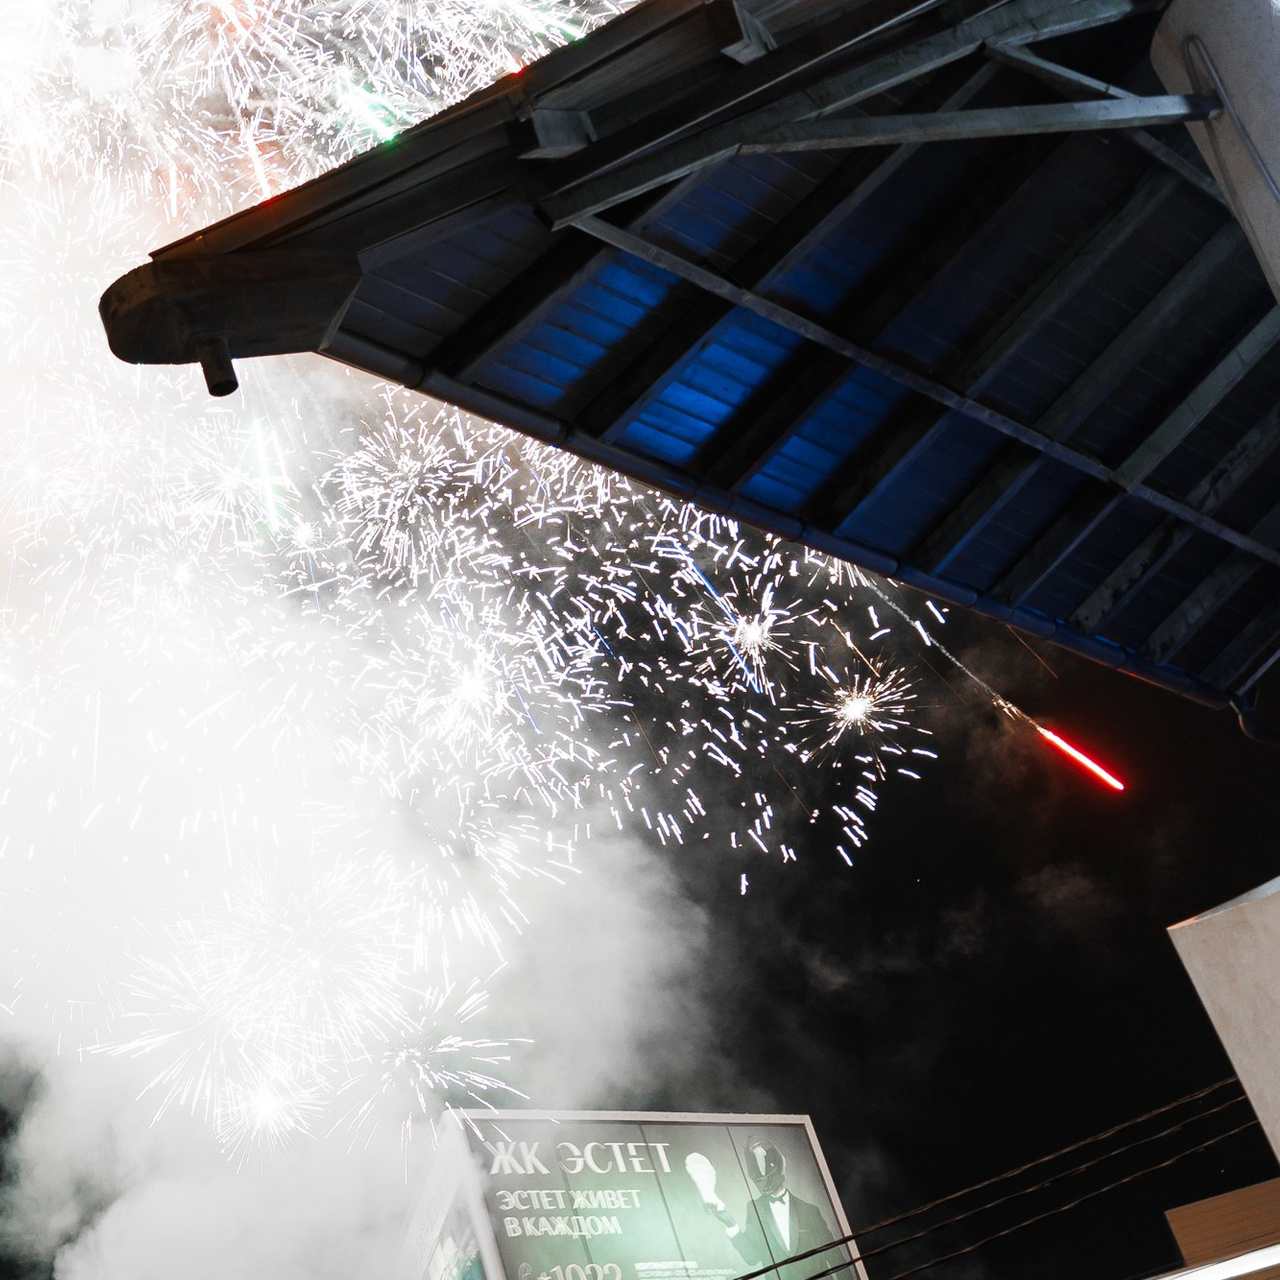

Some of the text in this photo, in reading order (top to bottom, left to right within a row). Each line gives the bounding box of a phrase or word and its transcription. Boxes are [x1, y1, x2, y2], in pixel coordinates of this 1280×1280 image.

[483, 1141, 672, 1175] ЖК ЭСТЕТ
[496, 1189, 641, 1211] ЭСТЕТ ЖИВЕТ
[503, 1215, 623, 1239] В КАЖДОМ
